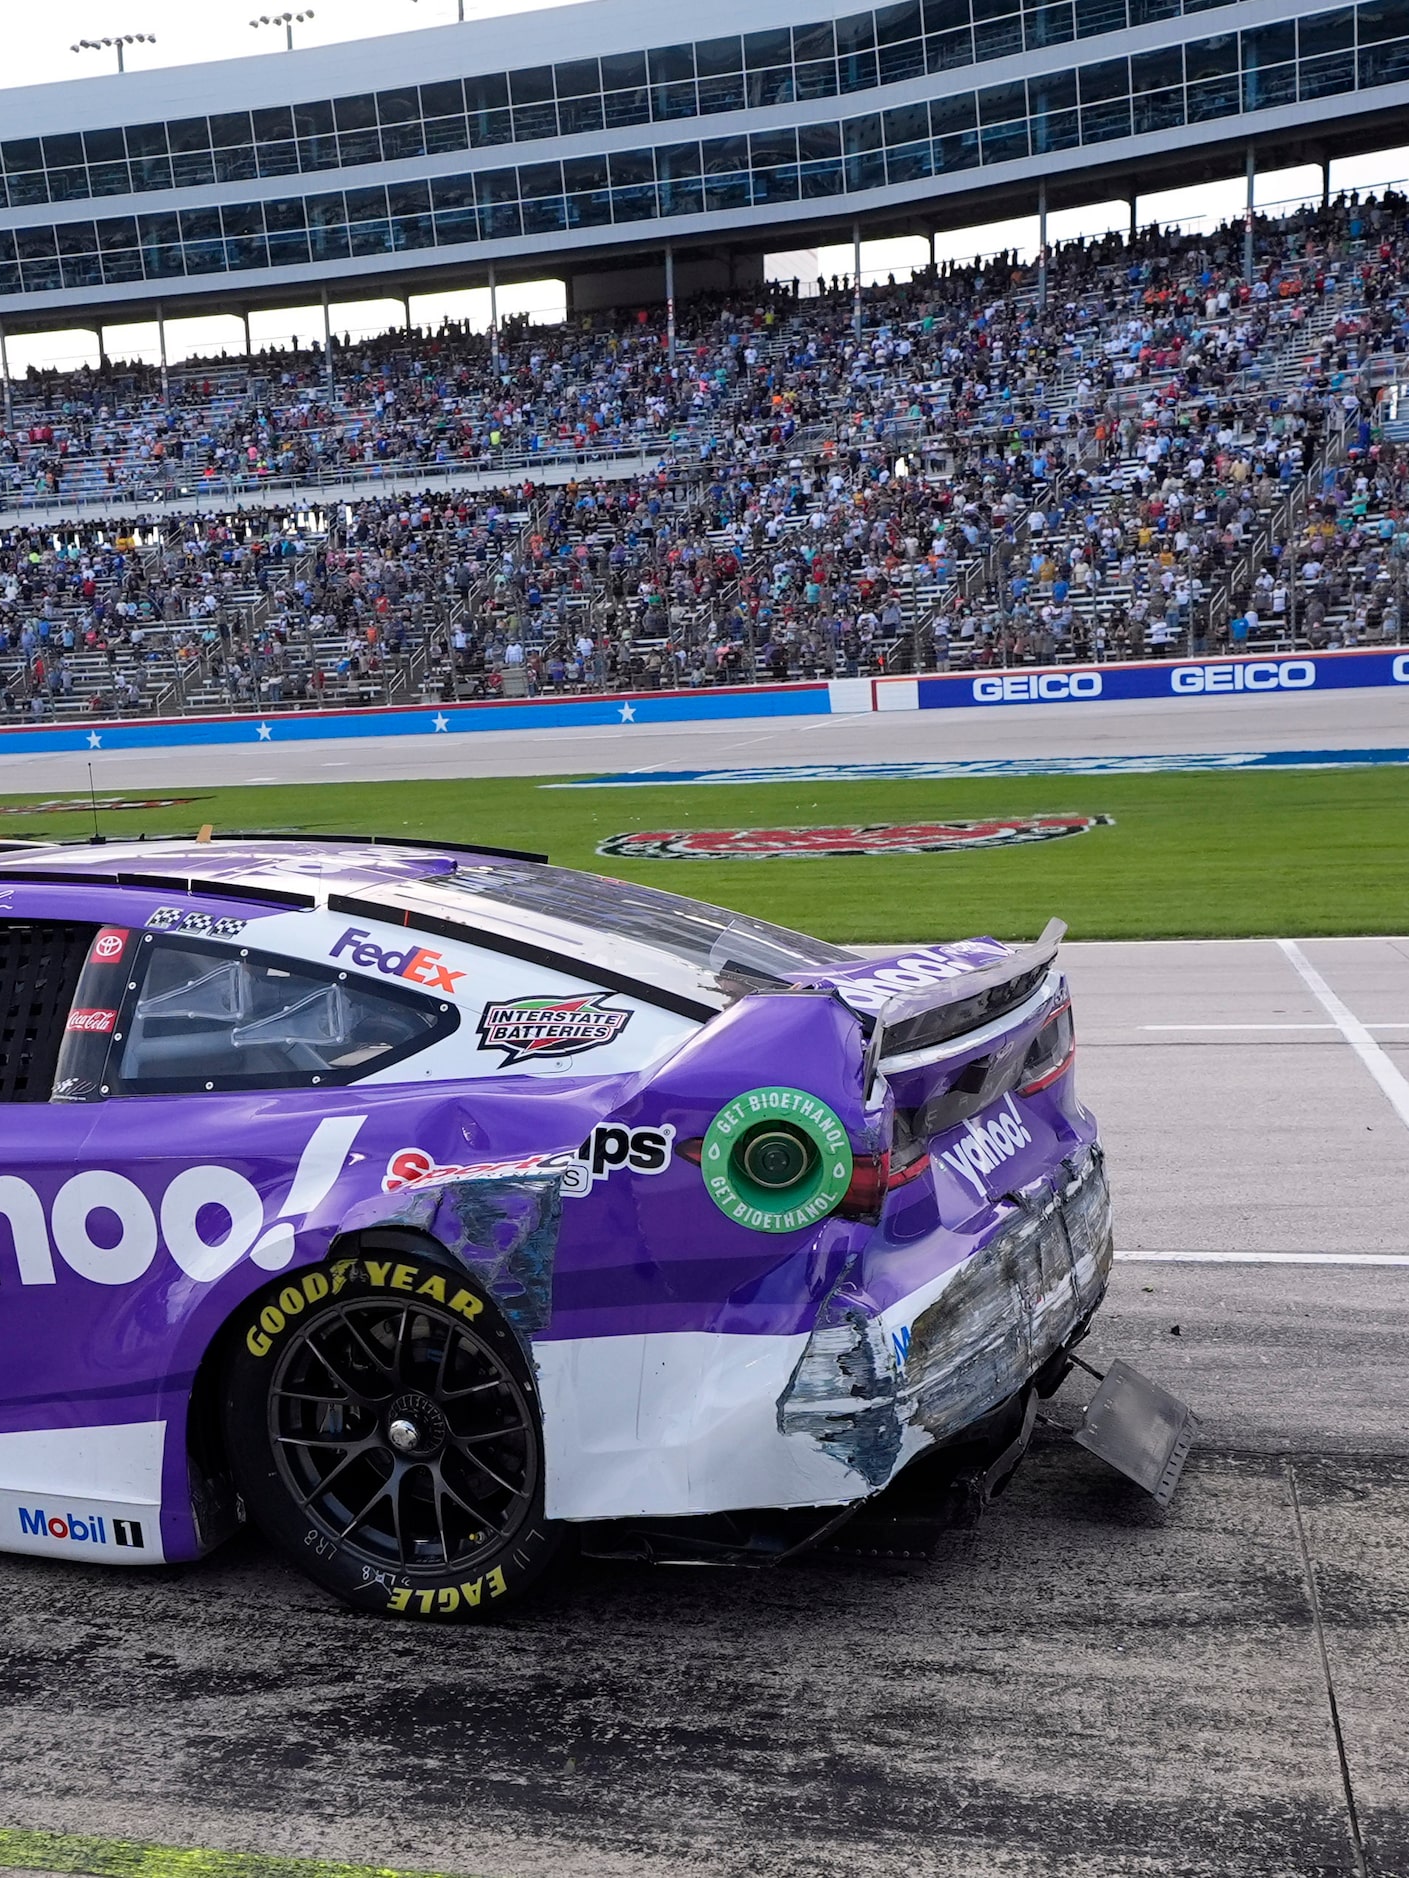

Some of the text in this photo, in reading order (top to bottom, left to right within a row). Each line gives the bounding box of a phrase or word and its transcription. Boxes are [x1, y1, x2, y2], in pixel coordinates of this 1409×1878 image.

[973, 671, 1103, 702] GEICO
[1171, 660, 1316, 694] GEICO
[328, 926, 468, 994] FedEx
[823, 950, 975, 1010] ahoo!
[491, 1010, 619, 1026] INTERSTATE
[493, 1025, 608, 1040] BATTERIES
[716, 1092, 845, 1154] GET BIOETHANOL
[941, 1091, 1032, 1198] yahoo!
[710, 1176, 838, 1229] GET BIOETHANOL
[246, 1259, 484, 1357] GOODYEAR
[18, 1507, 137, 1547] Mobil 1
[387, 1564, 508, 1614] EAGLE
